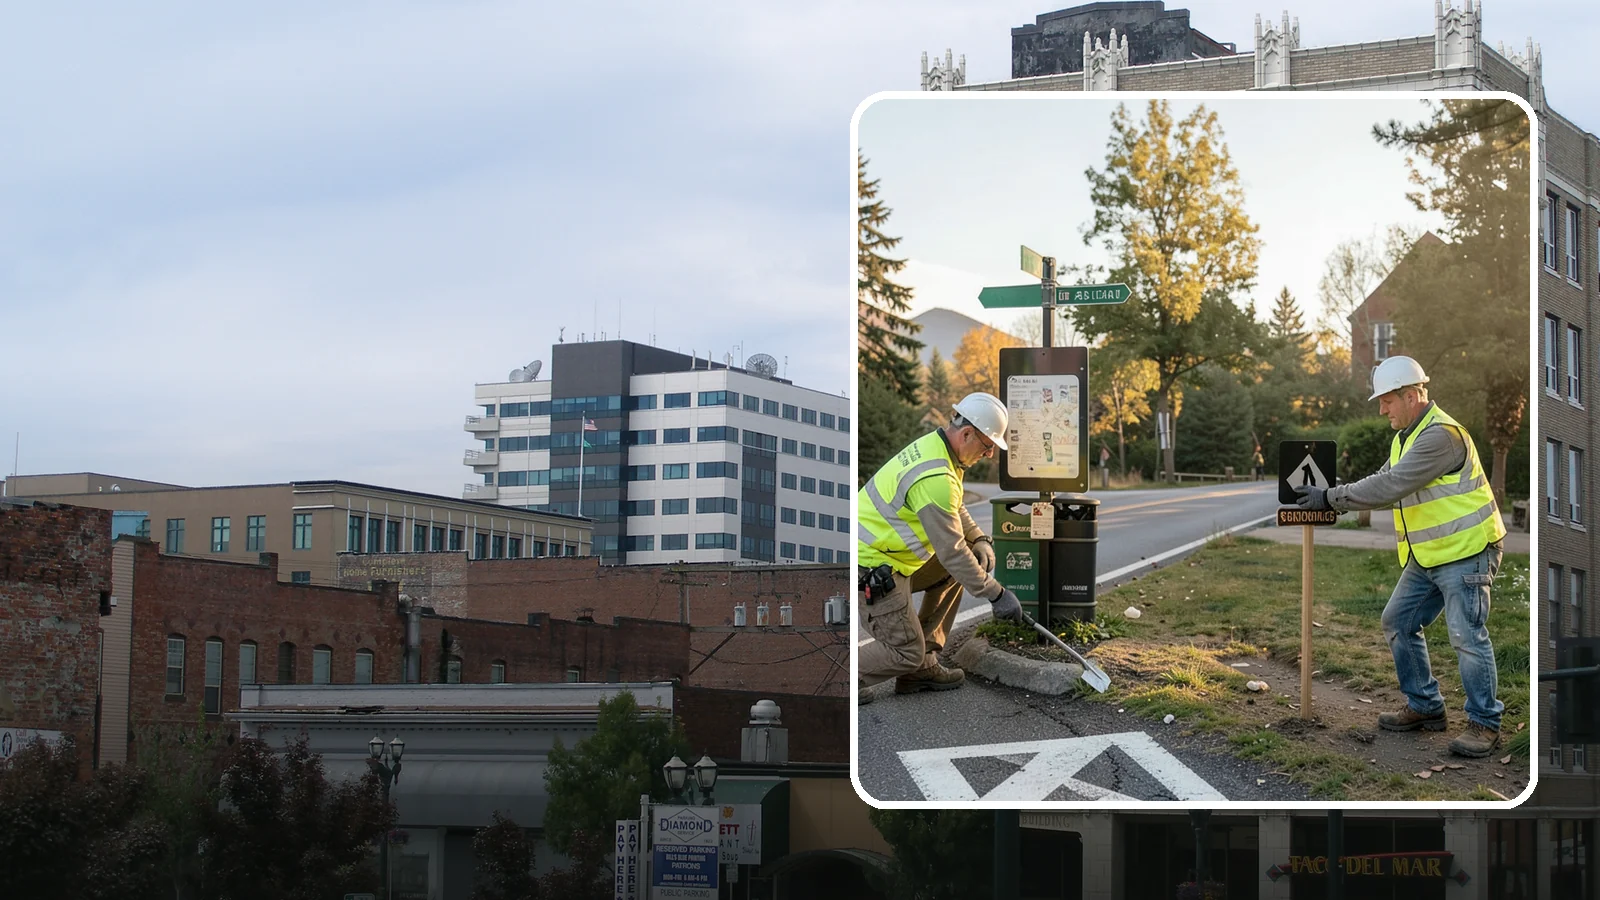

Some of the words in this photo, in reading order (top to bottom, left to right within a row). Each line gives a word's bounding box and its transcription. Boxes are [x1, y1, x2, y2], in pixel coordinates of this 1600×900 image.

[370, 565, 427, 576] Furnishers
[660, 818, 713, 833] DIAMOND
[1022, 815, 1070, 828] BUILDING
[617, 824, 625, 852] PAY
[628, 824, 637, 852] PAY
[655, 845, 688, 853] RESERVED
[689, 846, 716, 854] PARKING
[721, 851, 739, 863] Soup
[1289, 855, 1329, 875] TAC
[1346, 855, 1384, 876] DEL
[1392, 857, 1443, 877] MAR
[616, 856, 625, 893] HERE
[627, 855, 636, 893] HERE
[660, 888, 682, 897] PUBLIC
[683, 889, 710, 898] PARKING
